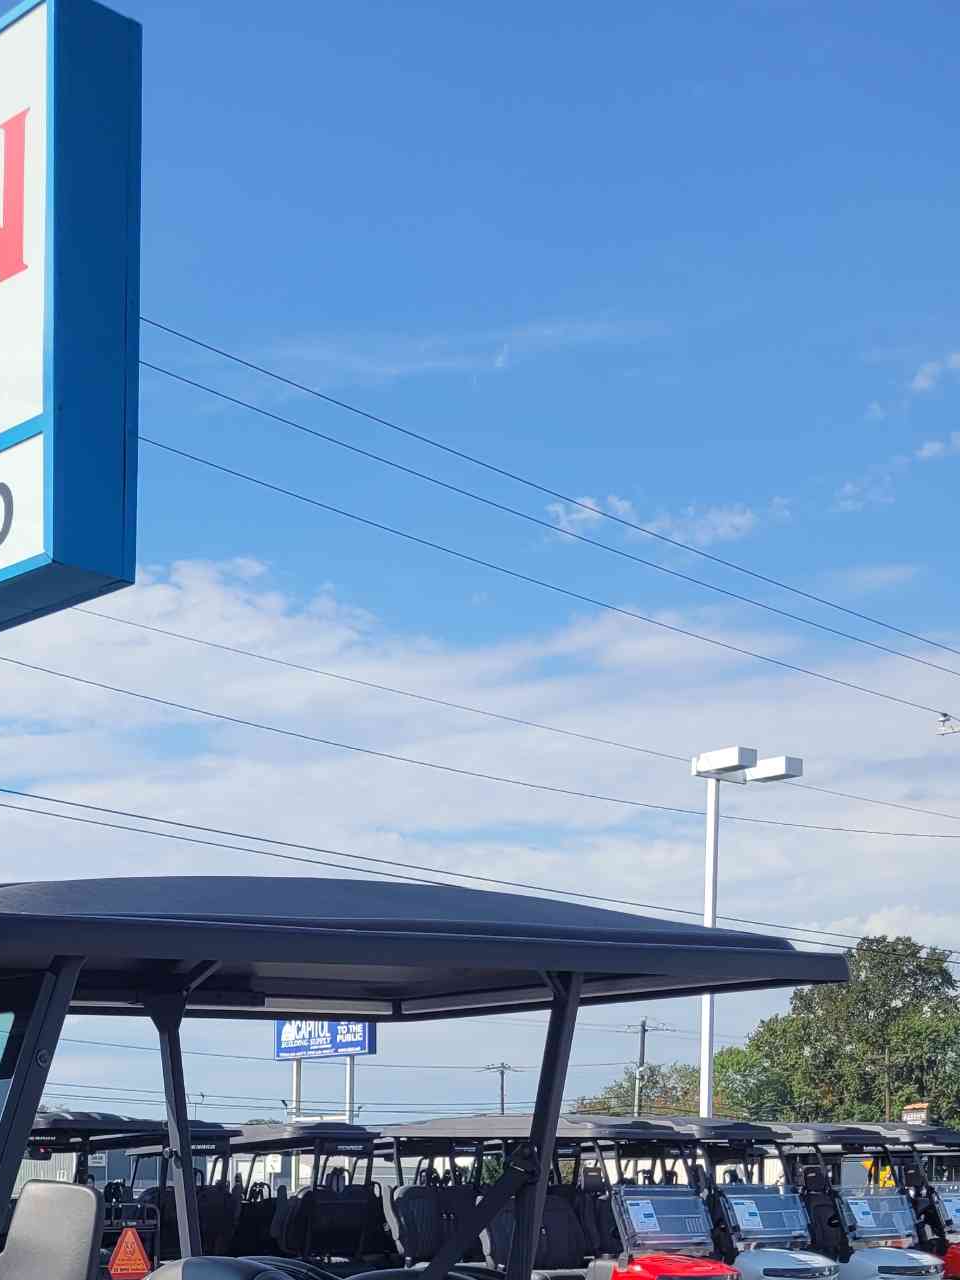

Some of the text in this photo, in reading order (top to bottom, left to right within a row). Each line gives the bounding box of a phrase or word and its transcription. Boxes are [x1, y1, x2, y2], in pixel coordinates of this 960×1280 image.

[337, 1024, 363, 1034] TO THE
[337, 1032, 363, 1042] PUBLIC
